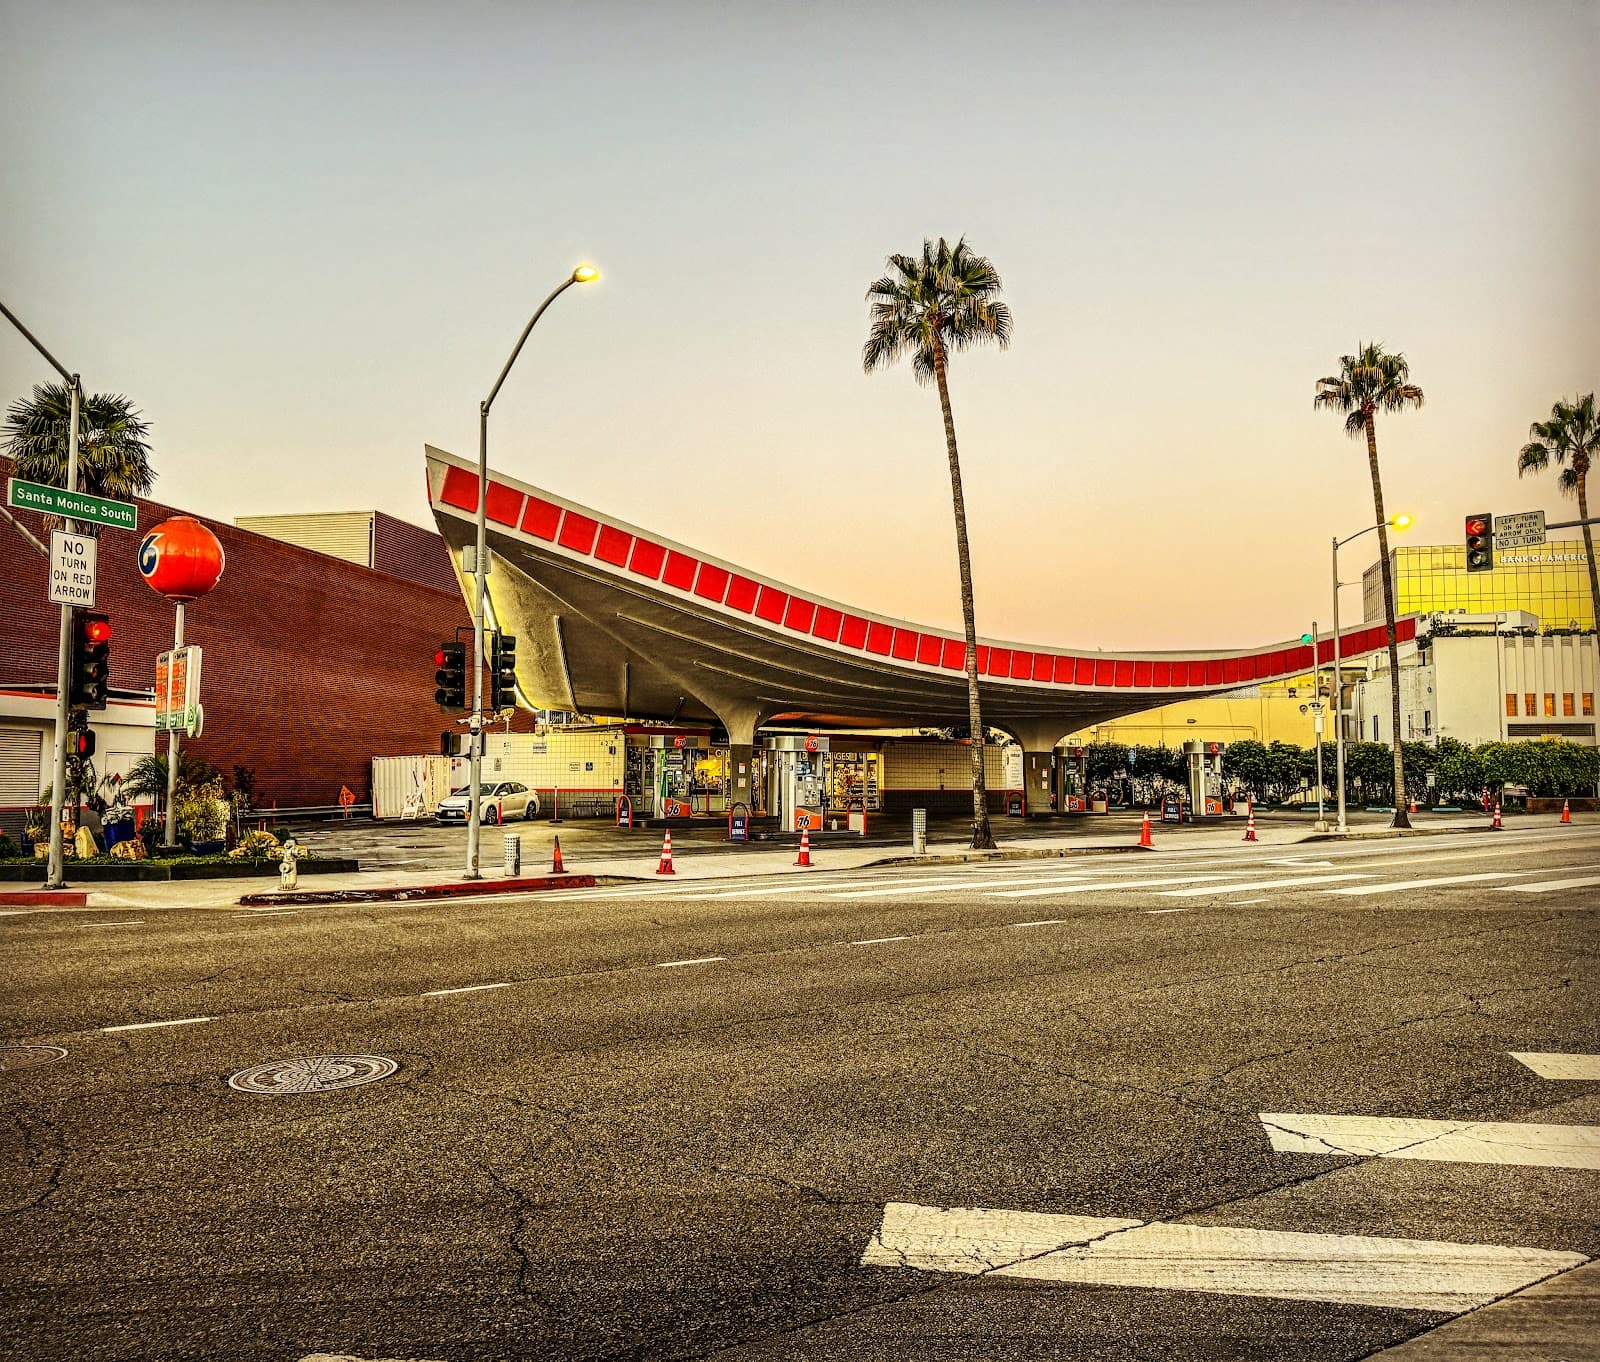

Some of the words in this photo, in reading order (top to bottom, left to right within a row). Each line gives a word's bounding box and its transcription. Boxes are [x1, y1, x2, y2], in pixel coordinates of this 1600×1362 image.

[17, 488, 53, 505] Santa
[57, 496, 97, 514] Monica
[100, 506, 132, 522] South
[1499, 530, 1522, 538] ARROW
[1522, 535, 1542, 544] TURN
[64, 540, 84, 555] NO
[138, 533, 165, 577] 6
[1500, 555, 1529, 563] BANK
[1531, 554, 1544, 562] OF
[1547, 553, 1588, 562] AMERIC
[61, 557, 87, 570] TURN
[53, 569, 67, 582] ON
[73, 573, 92, 585] RED
[54, 584, 90, 599] ARROW
[809, 740, 817, 748] 76
[667, 804, 680, 816] 76
[1207, 803, 1216, 812] 76
[797, 815, 810, 828] 76
